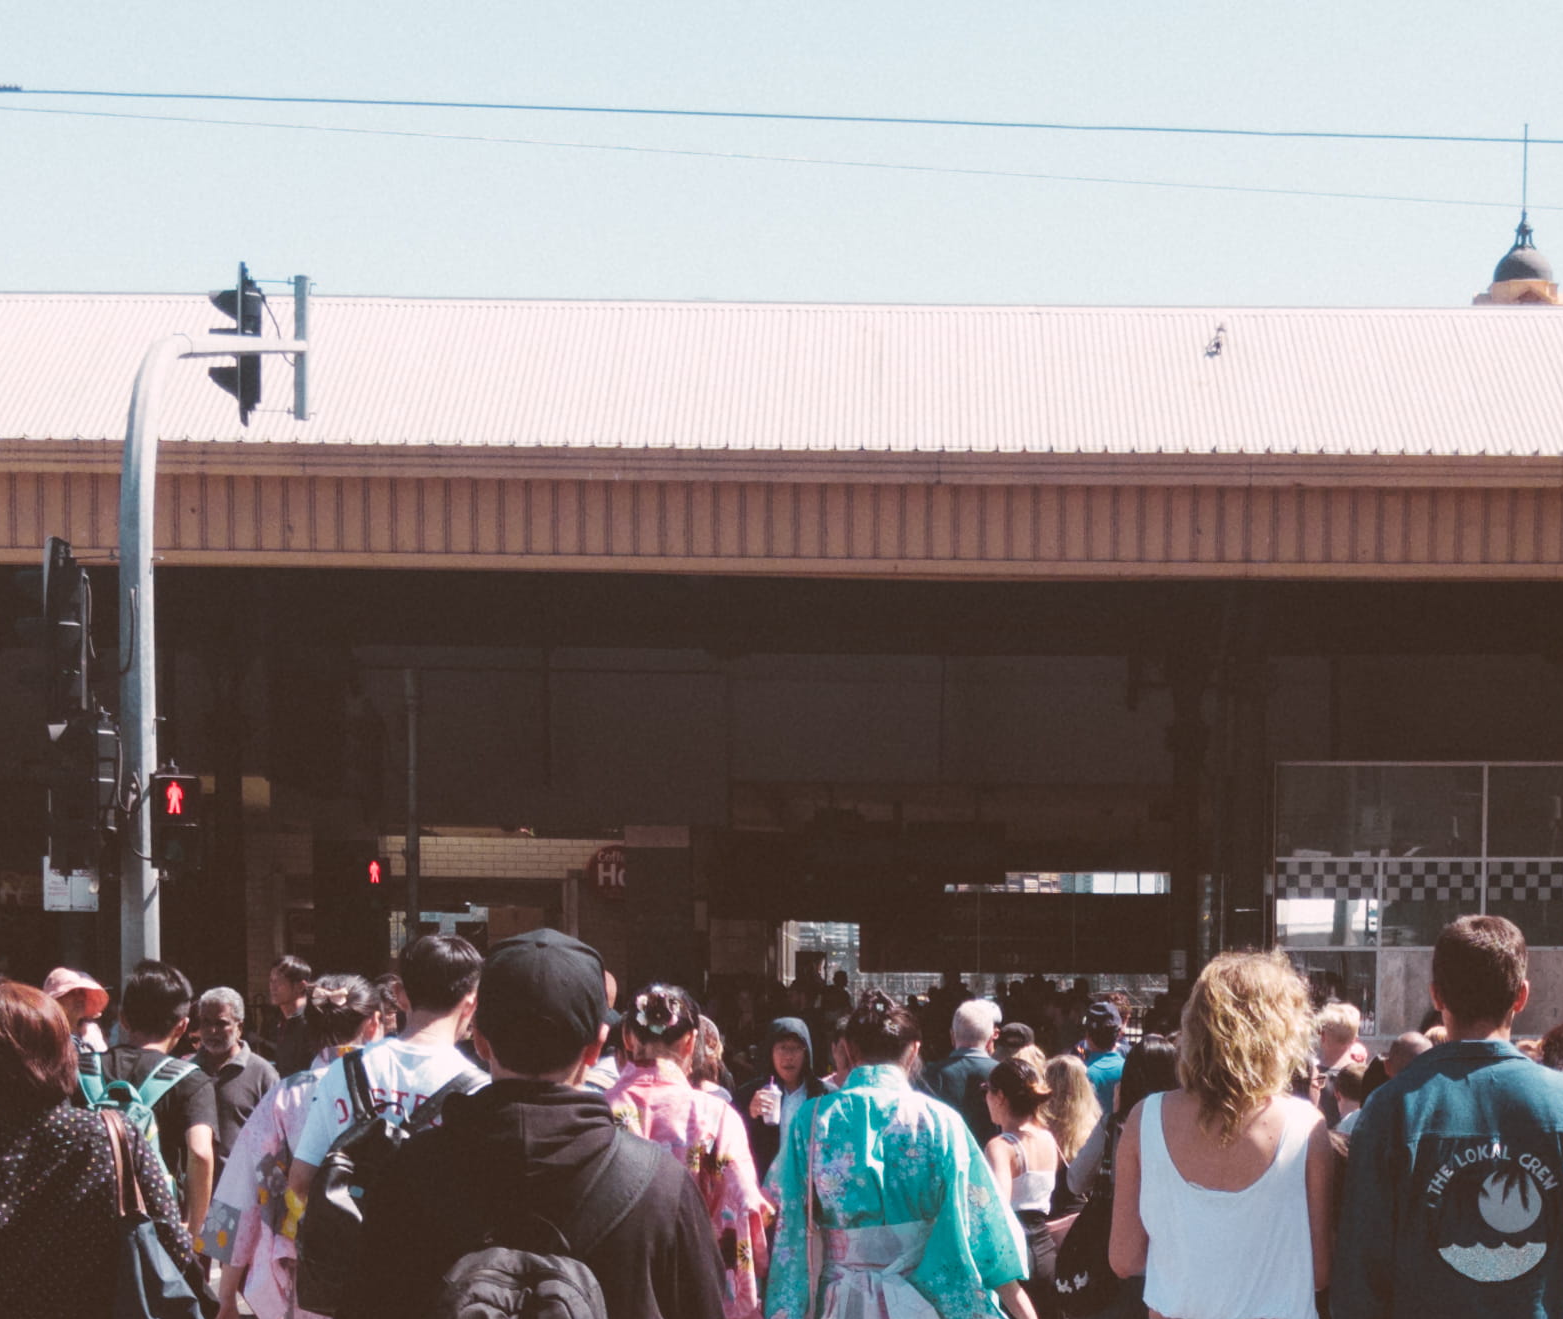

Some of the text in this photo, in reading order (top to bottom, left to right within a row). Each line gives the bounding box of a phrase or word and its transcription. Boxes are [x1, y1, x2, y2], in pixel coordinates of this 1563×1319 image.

[1427, 1143, 1559, 1195] THE LOKAL CREW
